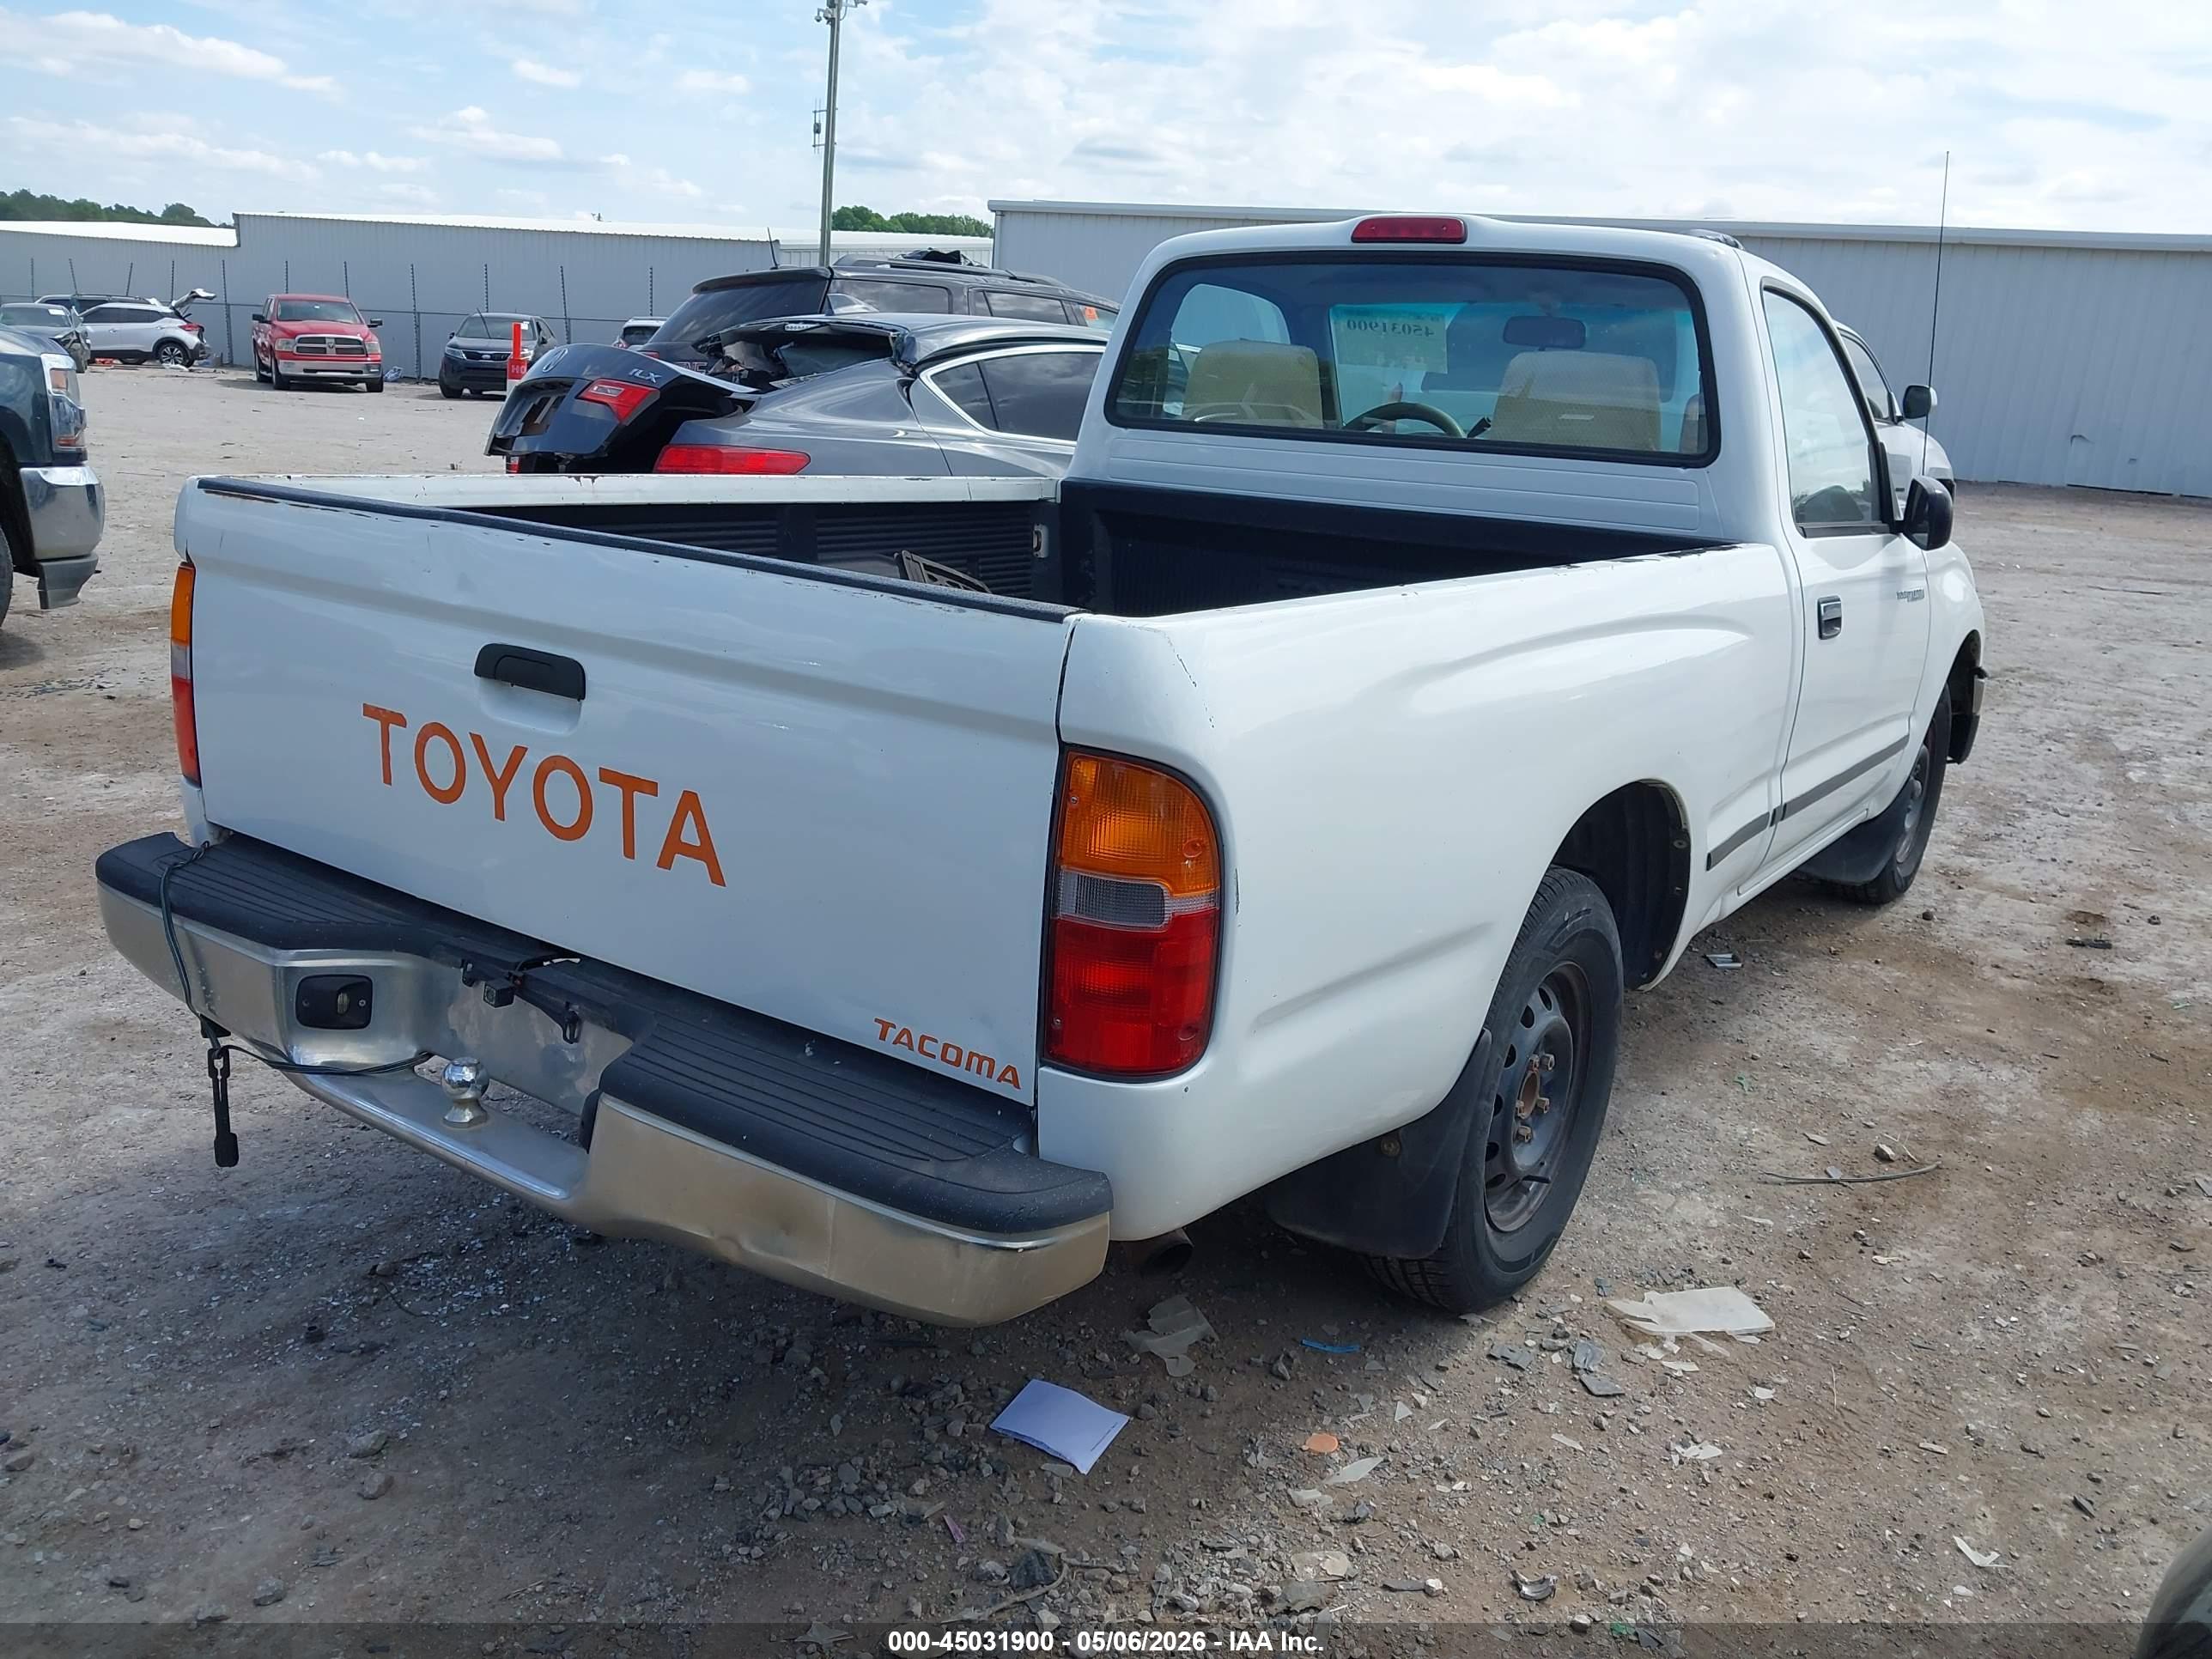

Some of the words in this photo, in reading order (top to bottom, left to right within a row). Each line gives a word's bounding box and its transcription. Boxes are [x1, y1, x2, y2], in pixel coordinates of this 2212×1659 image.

[628, 368, 662, 383] ILX
[362, 702, 726, 888] TOYOTA
[874, 1017, 1022, 1091] TACOMA
